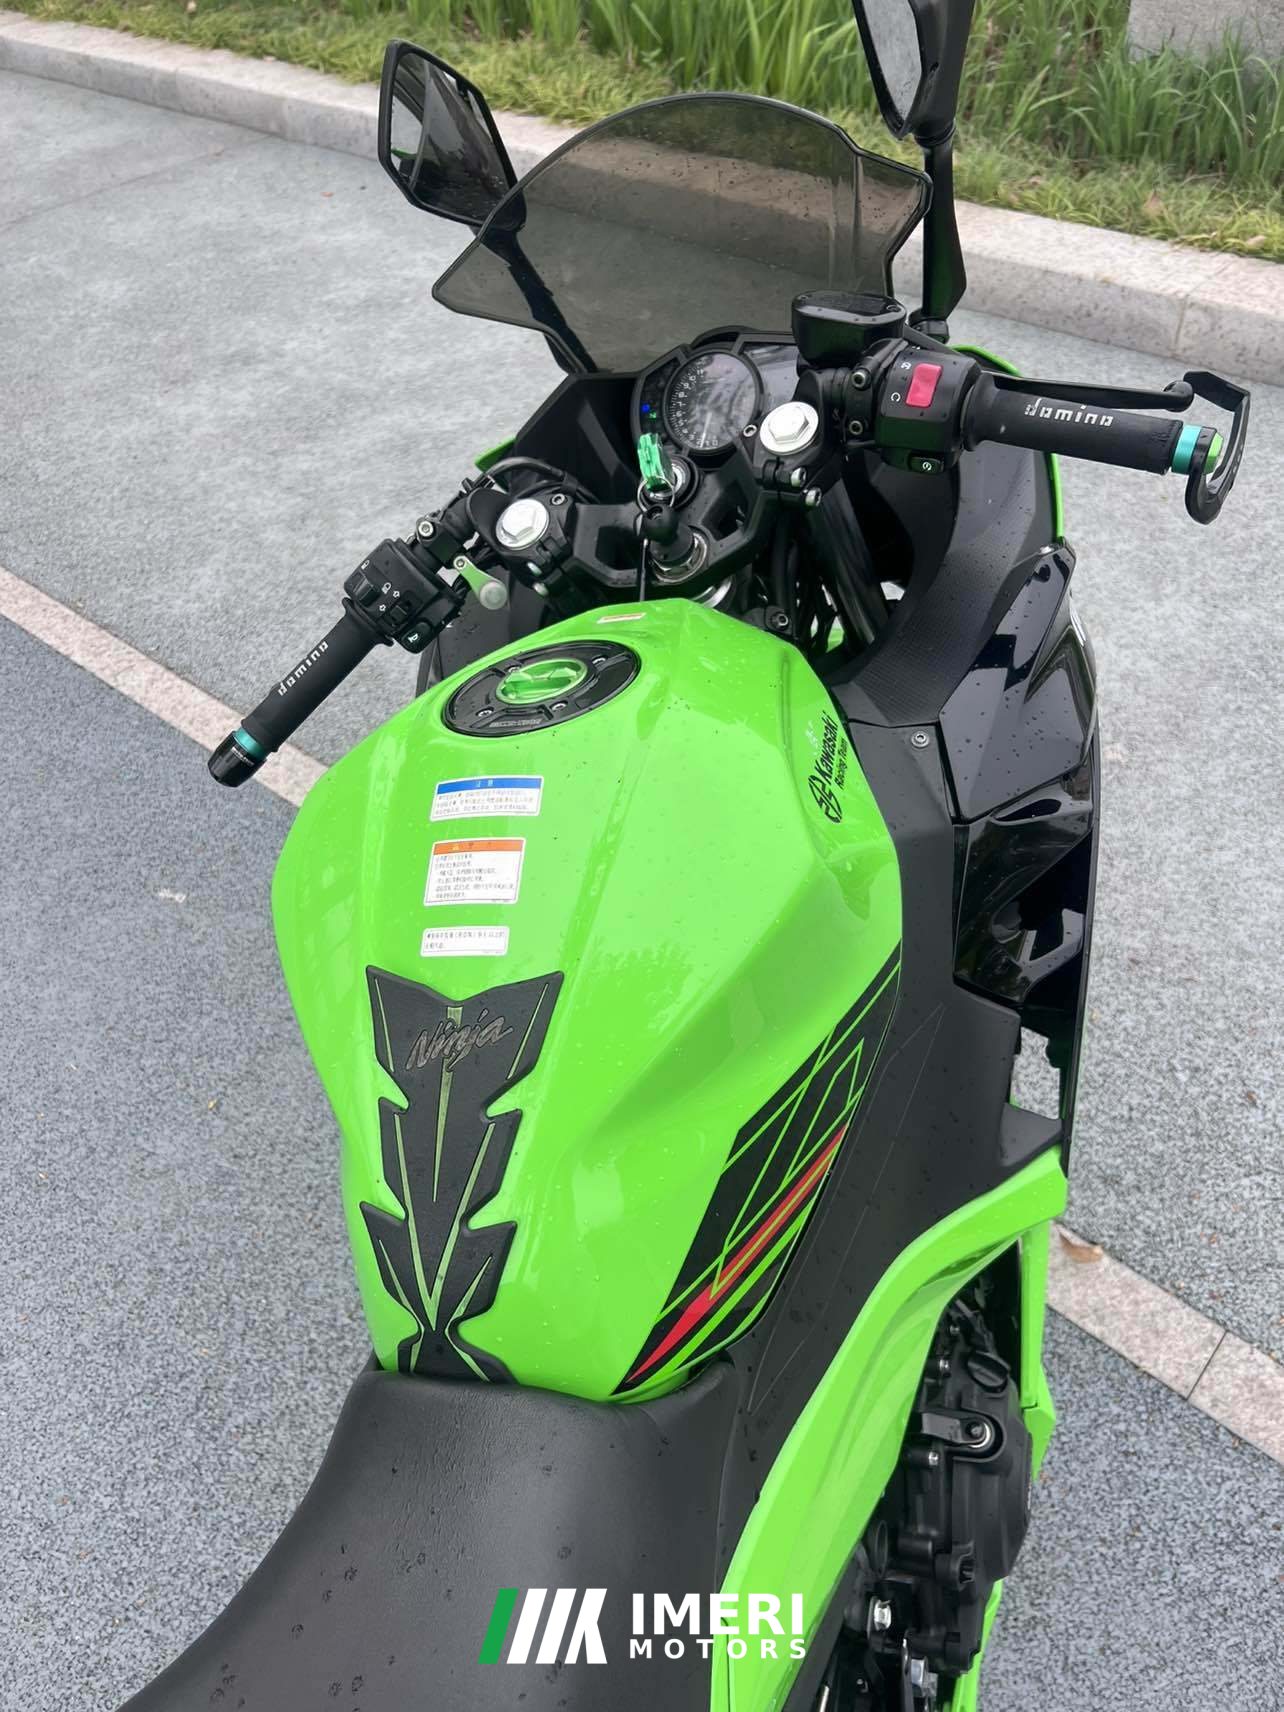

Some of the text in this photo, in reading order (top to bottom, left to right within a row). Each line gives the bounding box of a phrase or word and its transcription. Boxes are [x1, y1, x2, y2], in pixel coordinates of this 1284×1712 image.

[1024, 397, 1115, 427] domino
[277, 641, 329, 696] domino
[814, 709, 838, 786] Kawasaki
[405, 1007, 514, 1073] Ninja
